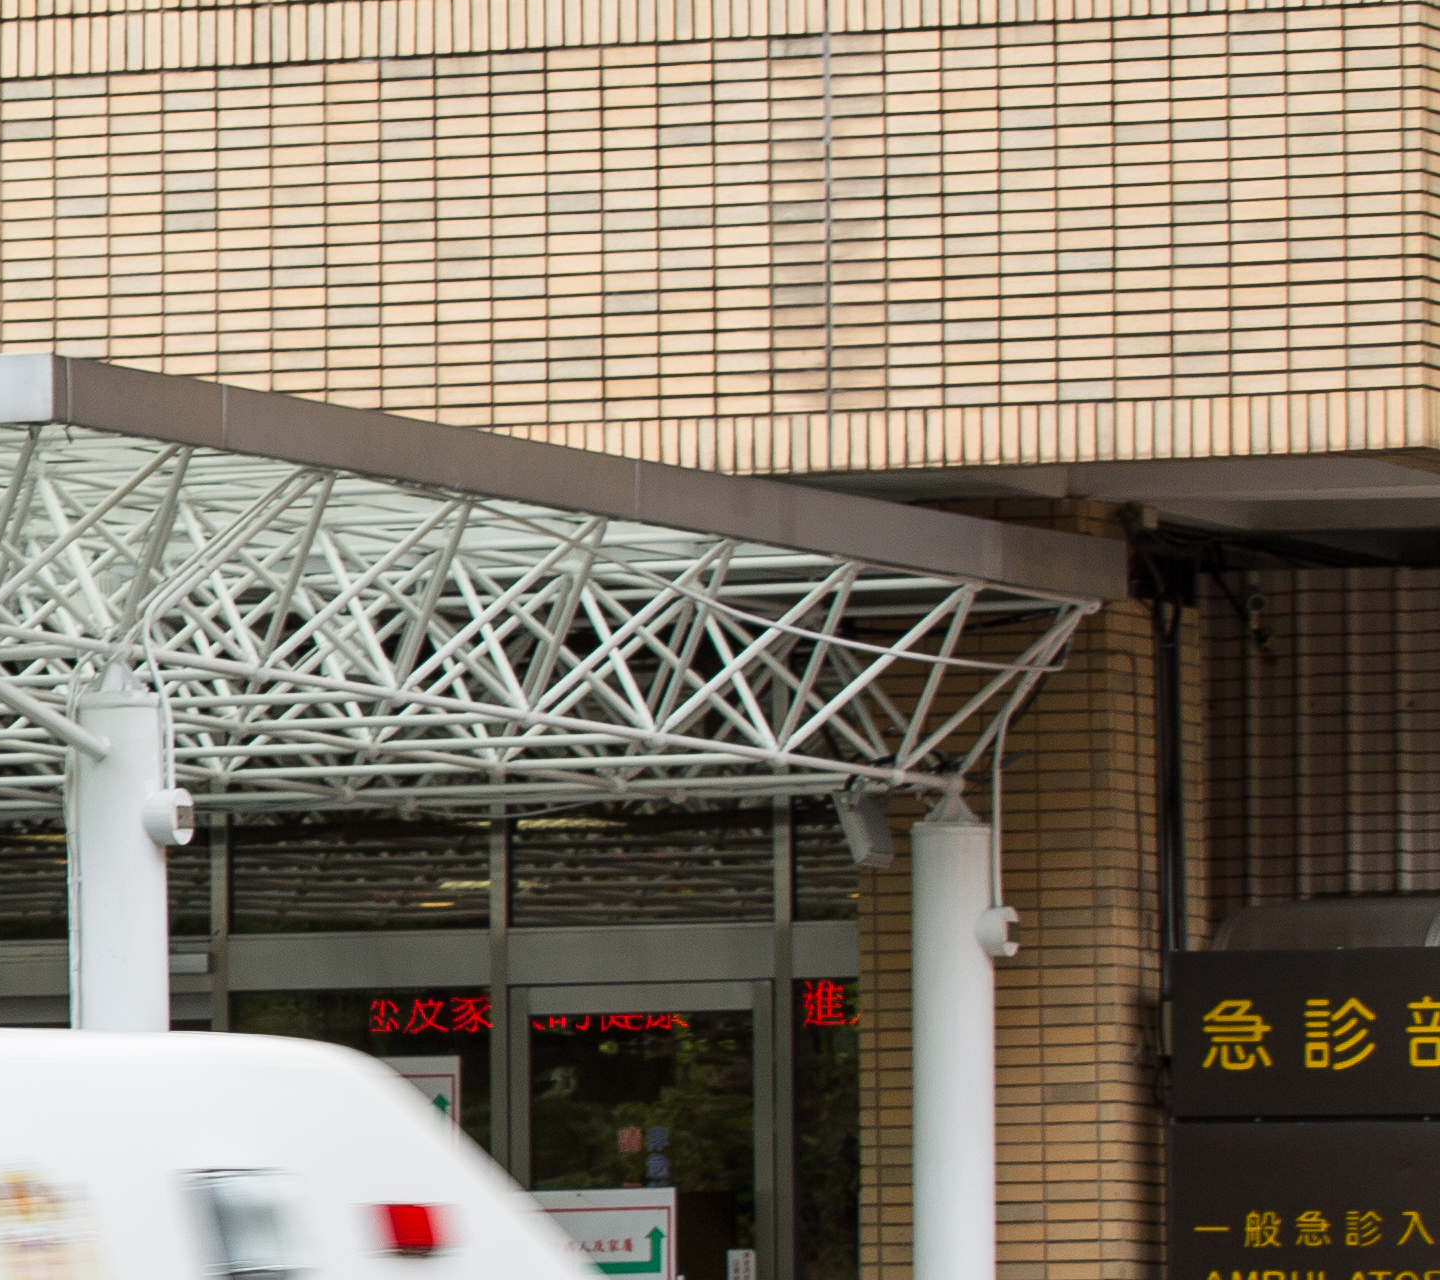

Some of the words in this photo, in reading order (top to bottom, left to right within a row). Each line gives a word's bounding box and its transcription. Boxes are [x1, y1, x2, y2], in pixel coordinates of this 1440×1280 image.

[1193, 1210, 1435, 1248] 一般急診入
